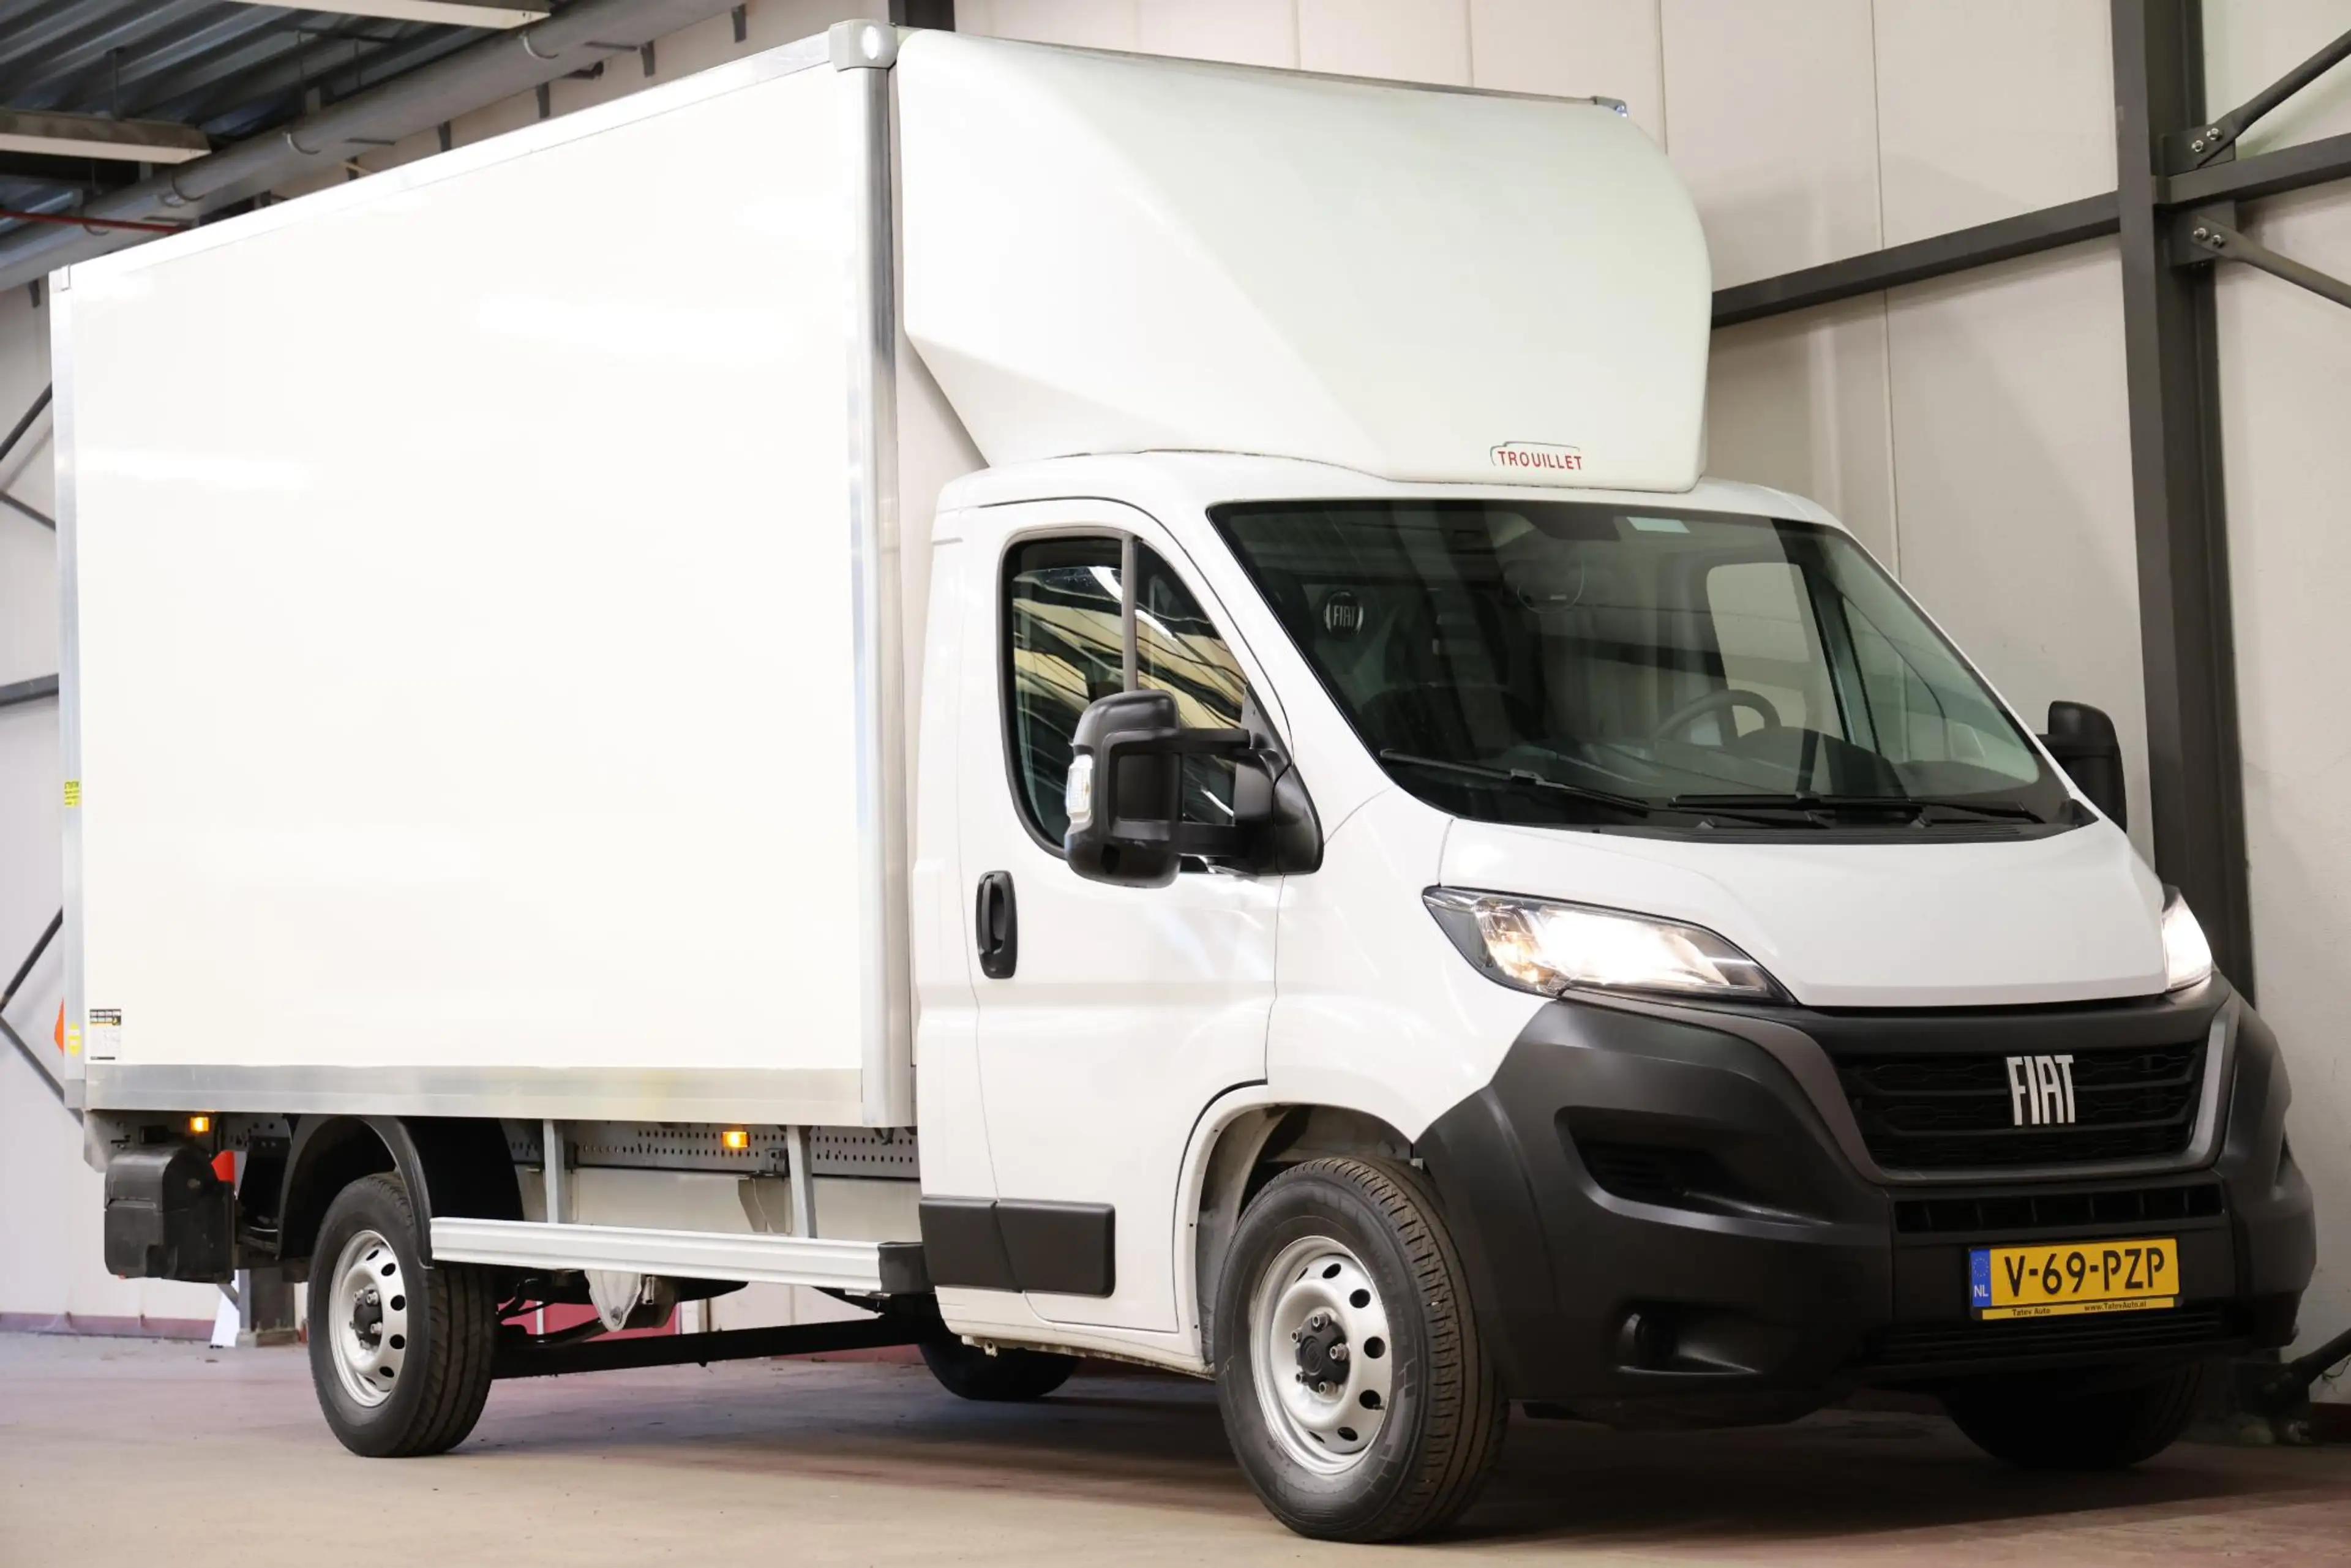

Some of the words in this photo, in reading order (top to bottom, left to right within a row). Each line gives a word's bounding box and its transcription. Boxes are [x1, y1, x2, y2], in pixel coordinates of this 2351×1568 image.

[1498, 451, 1581, 470] TROUILLET
[1333, 604, 1356, 628] FIAT
[2006, 1054, 2075, 1125] FIAT
[2004, 1247, 2165, 1297] V-69-PZP
[1974, 1284, 1989, 1297] NL
[2034, 1307, 2051, 1315] Auto
